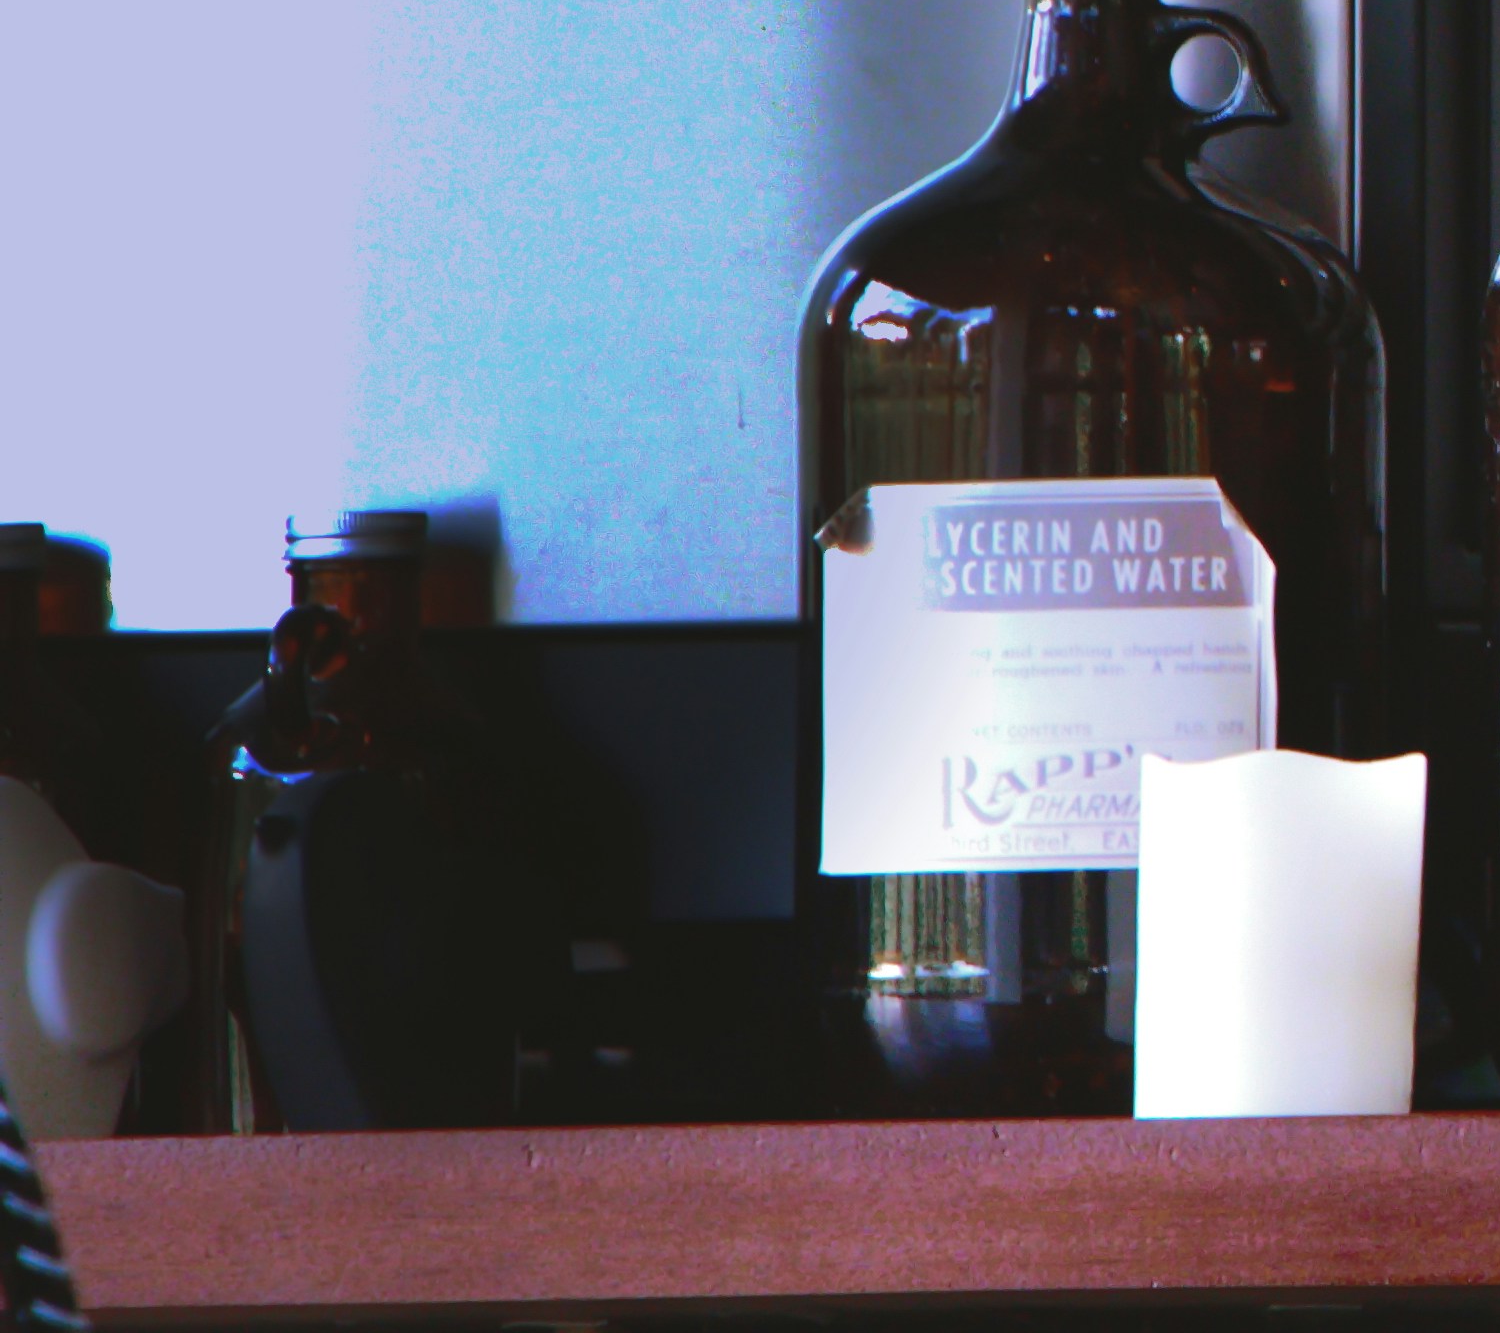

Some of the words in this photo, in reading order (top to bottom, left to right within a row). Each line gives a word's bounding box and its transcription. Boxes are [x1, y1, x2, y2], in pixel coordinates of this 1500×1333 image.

[928, 517, 1071, 558] LYCERIN
[1090, 517, 1164, 554] AND
[1113, 556, 1228, 593] WATER
[941, 742, 1140, 832] RAPP'
